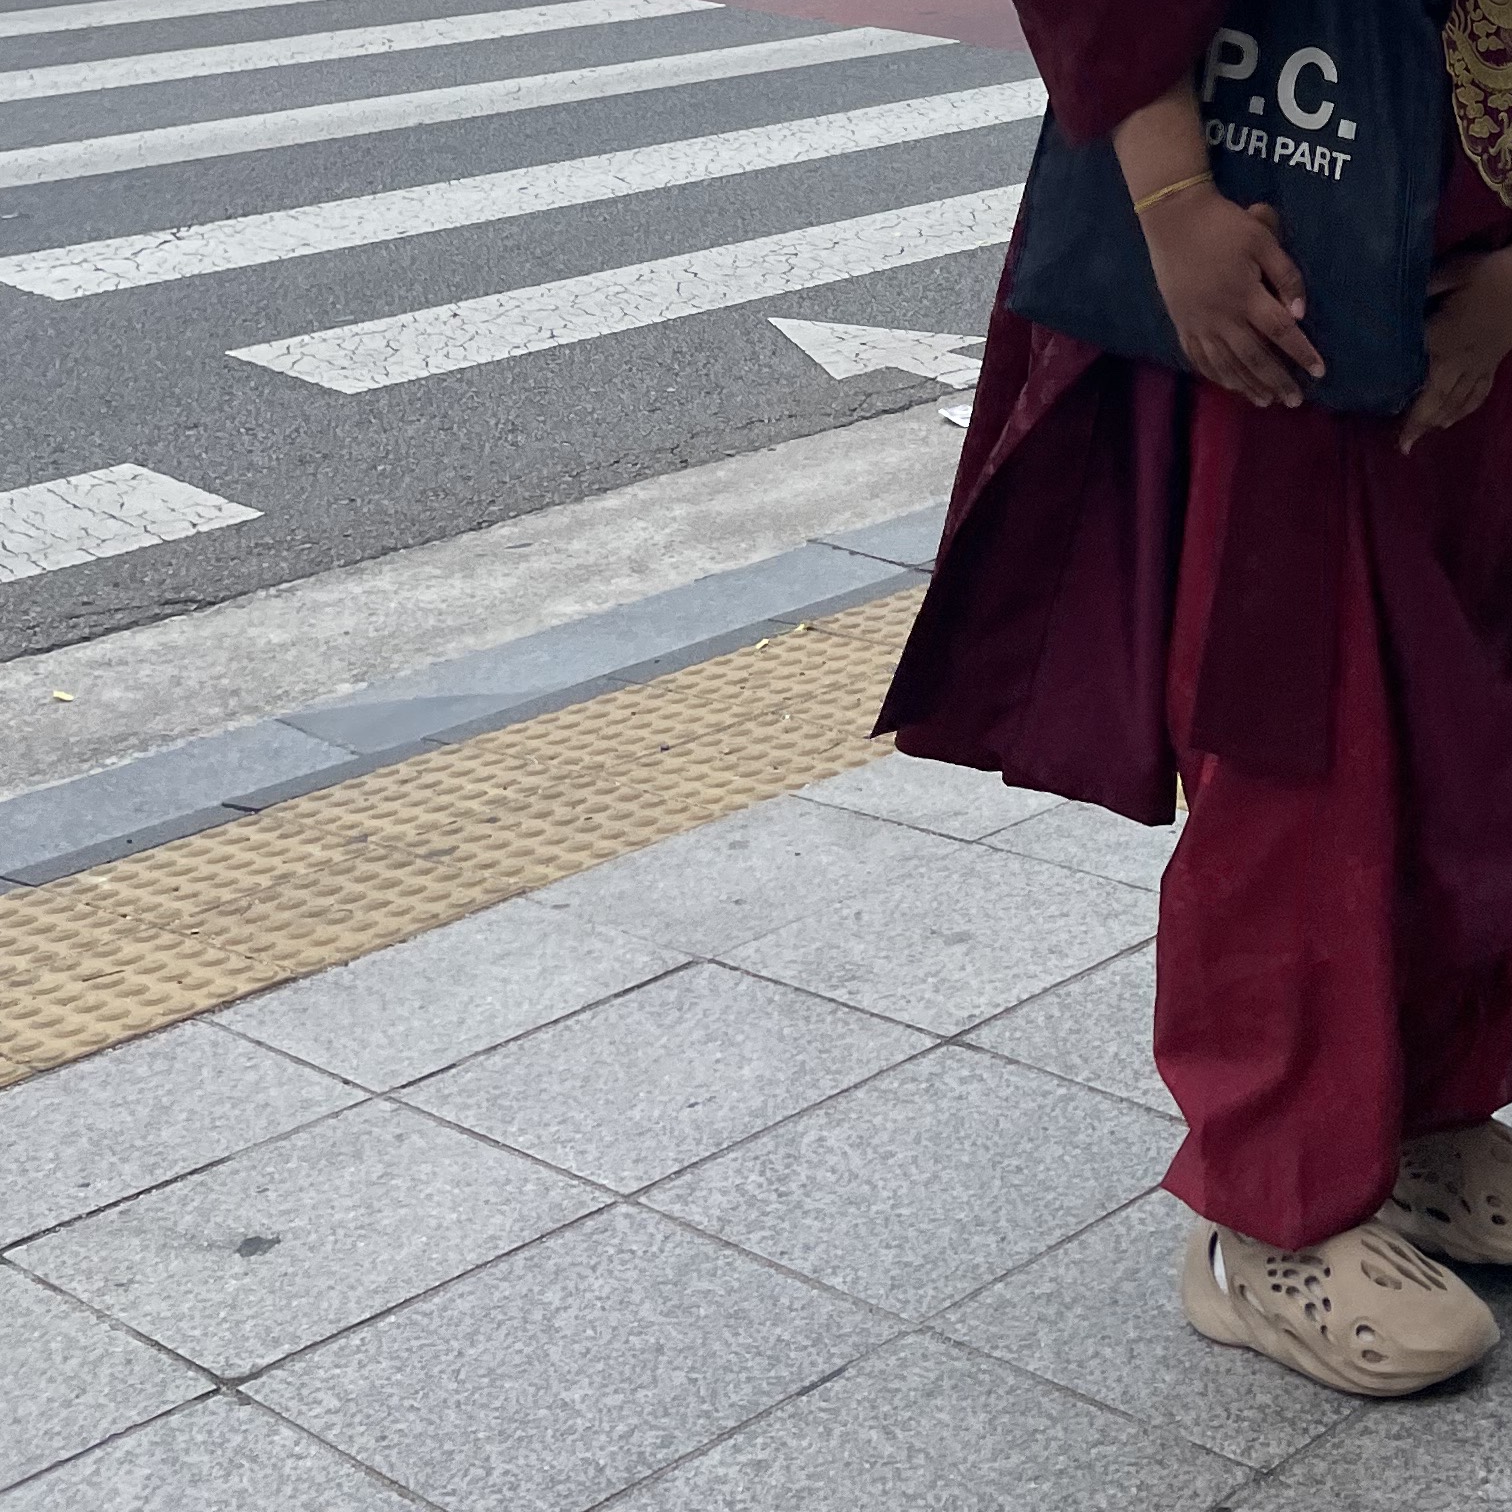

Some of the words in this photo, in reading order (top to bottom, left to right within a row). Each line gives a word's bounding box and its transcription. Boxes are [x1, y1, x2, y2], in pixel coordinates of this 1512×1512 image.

[1202, 27, 1357, 141] P.C.
[1205, 118, 1269, 159] OUR
[1273, 136, 1352, 180] PART
